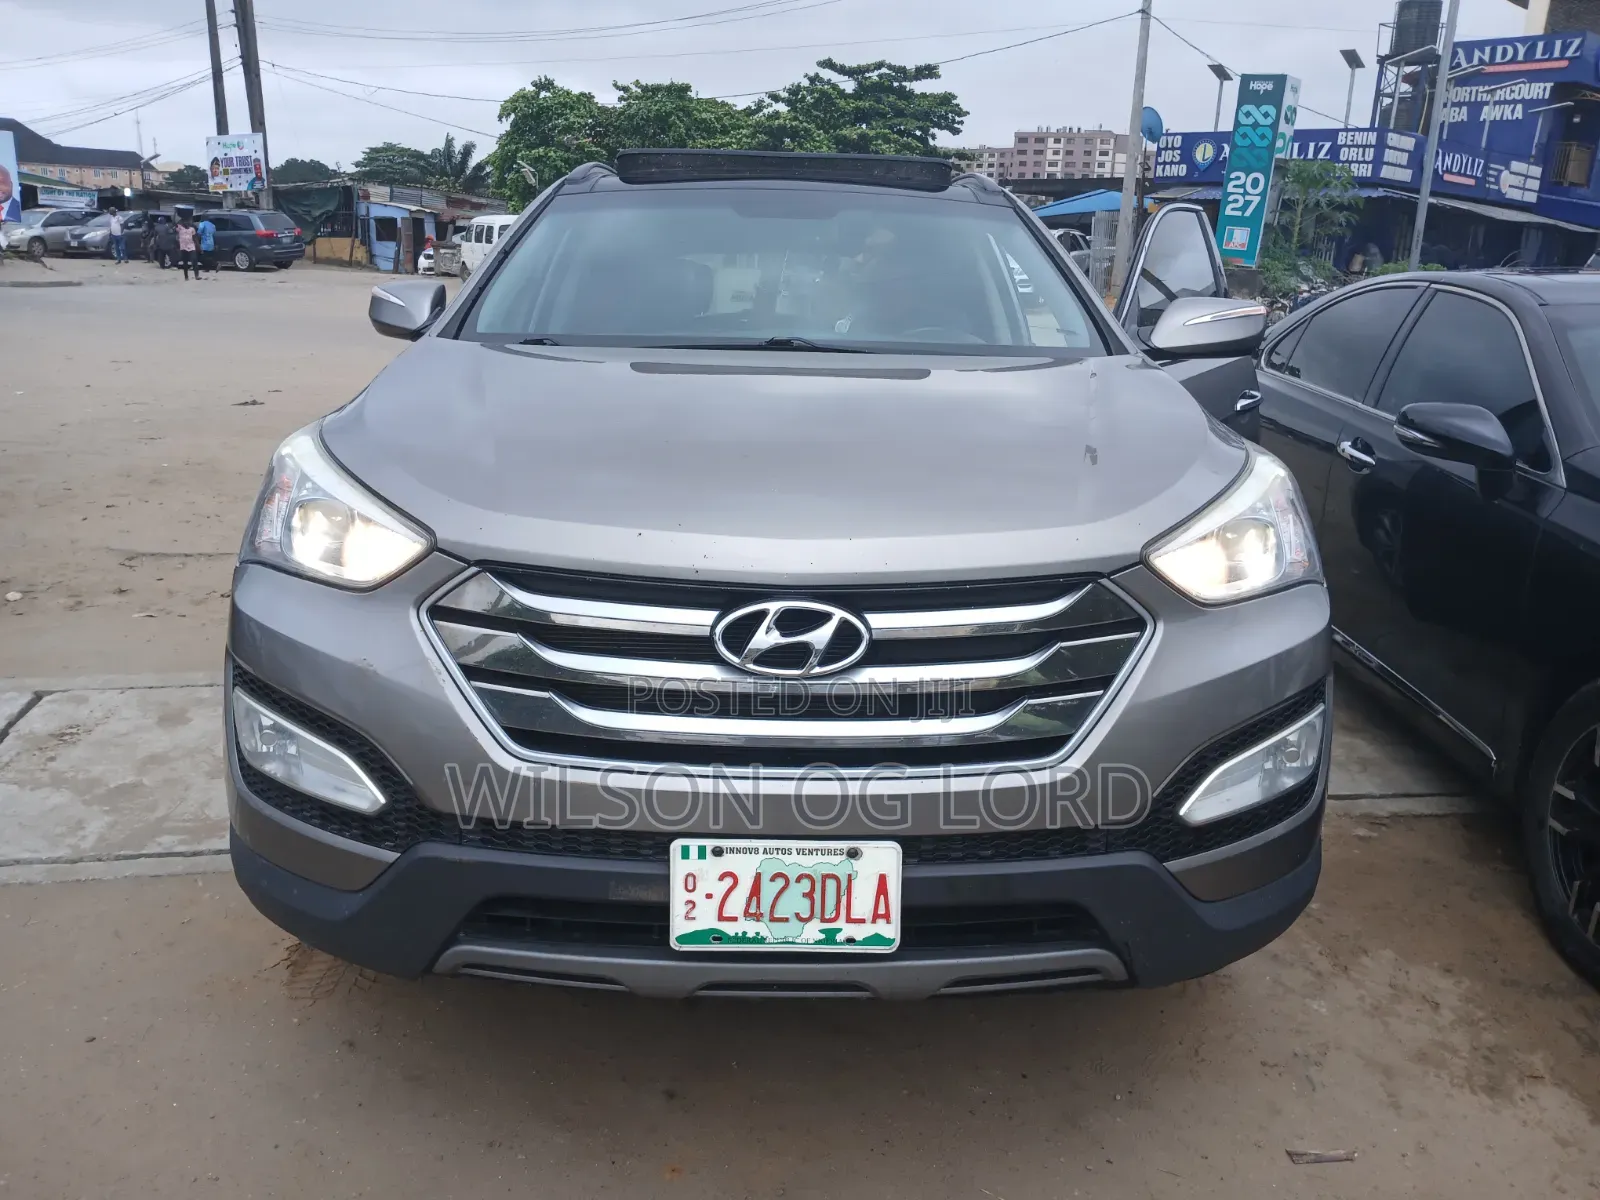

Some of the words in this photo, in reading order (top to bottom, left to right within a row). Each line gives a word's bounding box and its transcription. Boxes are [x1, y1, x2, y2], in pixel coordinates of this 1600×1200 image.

[1452, 37, 1583, 68] ANDYLIZ
[1249, 80, 1274, 95] Hope
[1480, 104, 1523, 122] AWKA
[1159, 136, 1182, 148] OYO
[1337, 132, 1377, 145] BENIN
[1158, 150, 1181, 162] JOS
[1340, 147, 1374, 161] ORLU
[1435, 149, 1484, 177] ANDYLIZ
[1156, 164, 1187, 177] KANO
[1226, 171, 1265, 195] 20
[1225, 194, 1261, 217] 27
[725, 846, 760, 855] INNOV8
[762, 847, 793, 856] AUTOS
[796, 848, 845, 856] VENTURES
